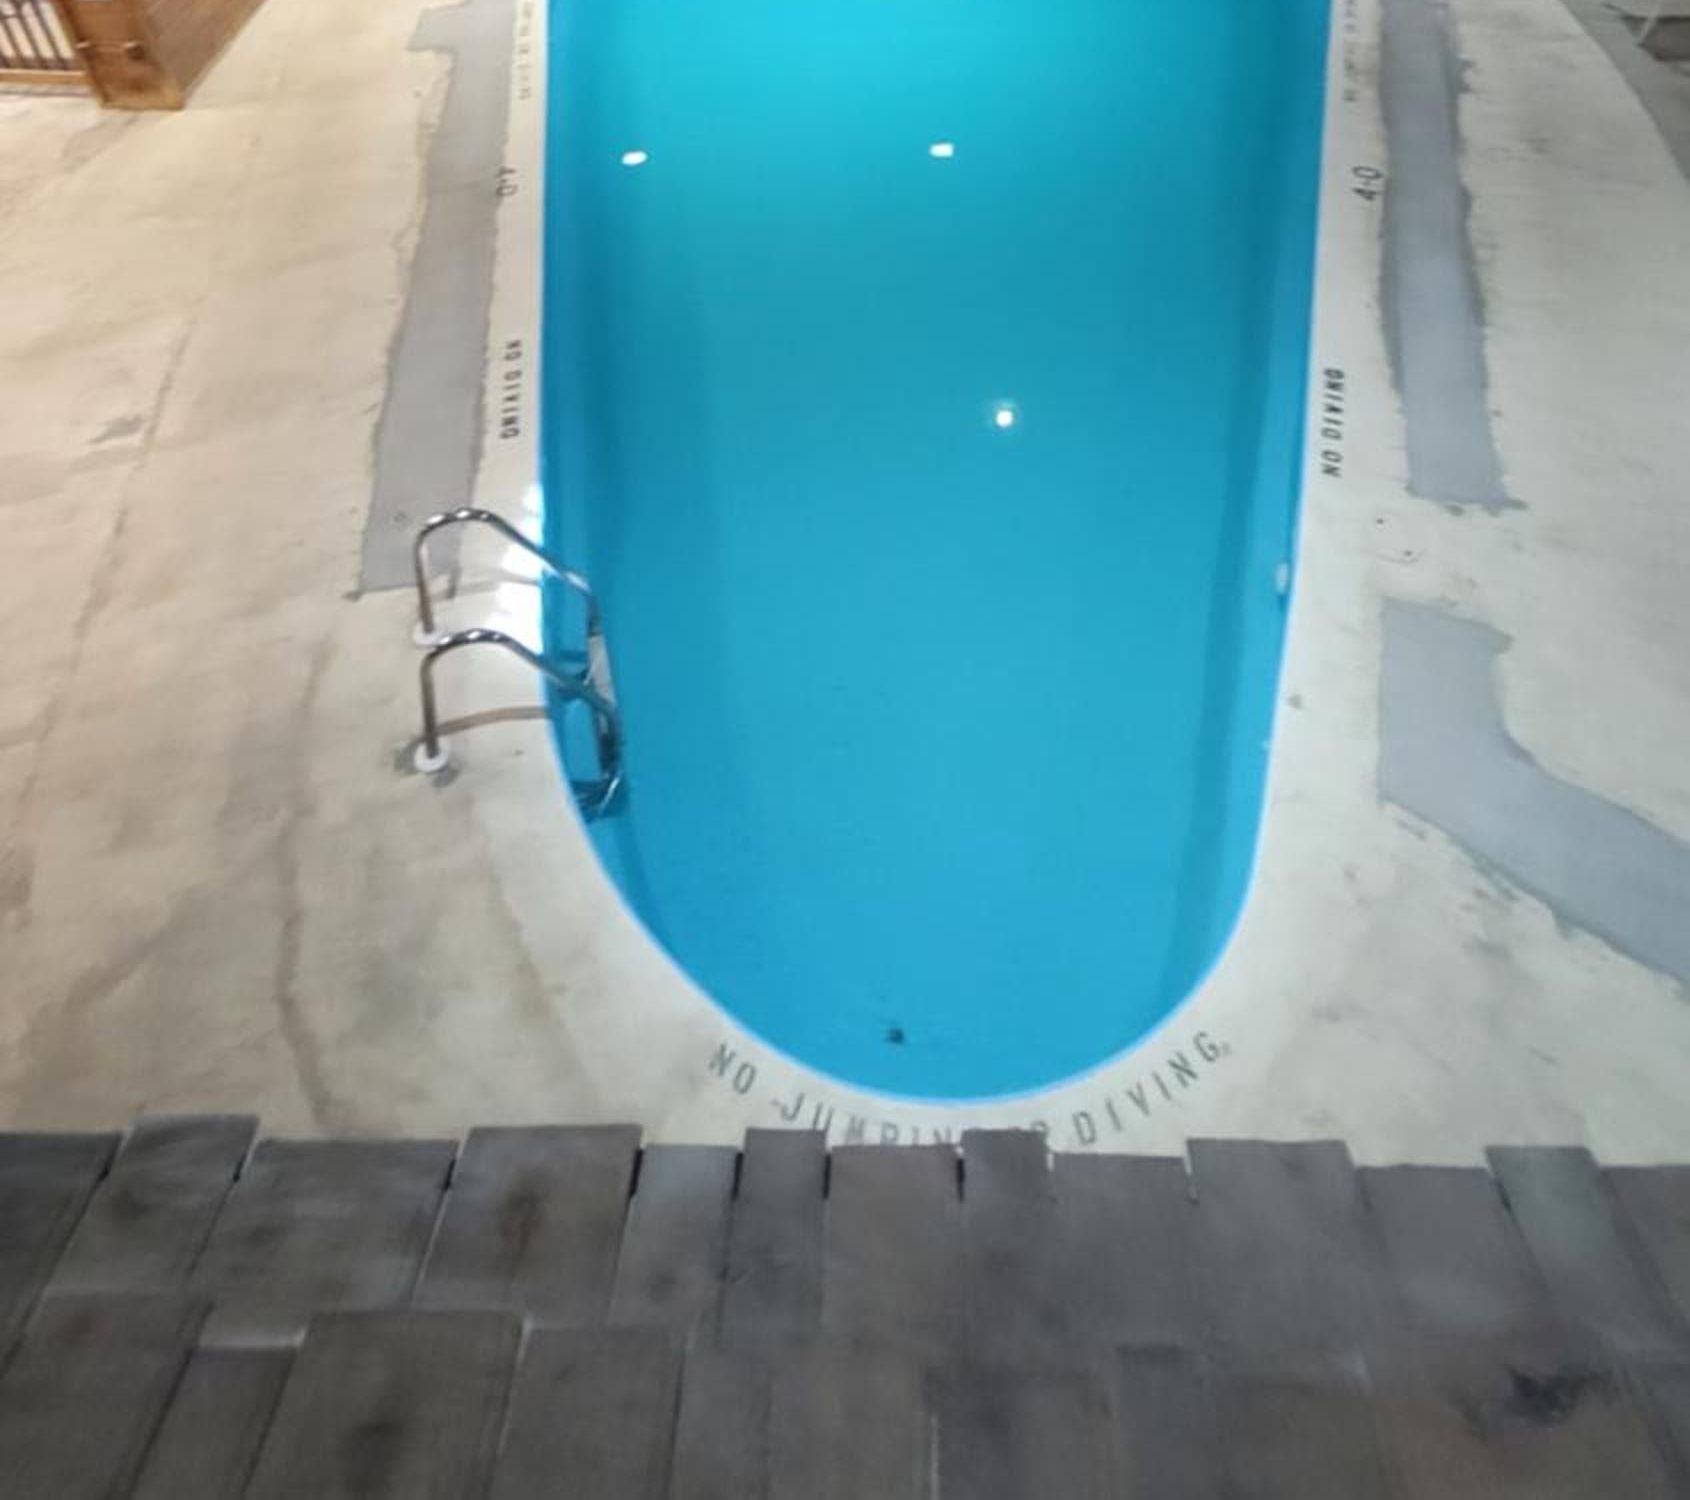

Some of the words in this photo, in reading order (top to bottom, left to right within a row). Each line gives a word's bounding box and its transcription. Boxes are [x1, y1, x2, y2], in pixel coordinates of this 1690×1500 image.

[499, 369, 523, 439] DIVING
[1321, 367, 1345, 440] DIVING
[1320, 450, 1344, 478] NO
[708, 1043, 757, 1094] NO
